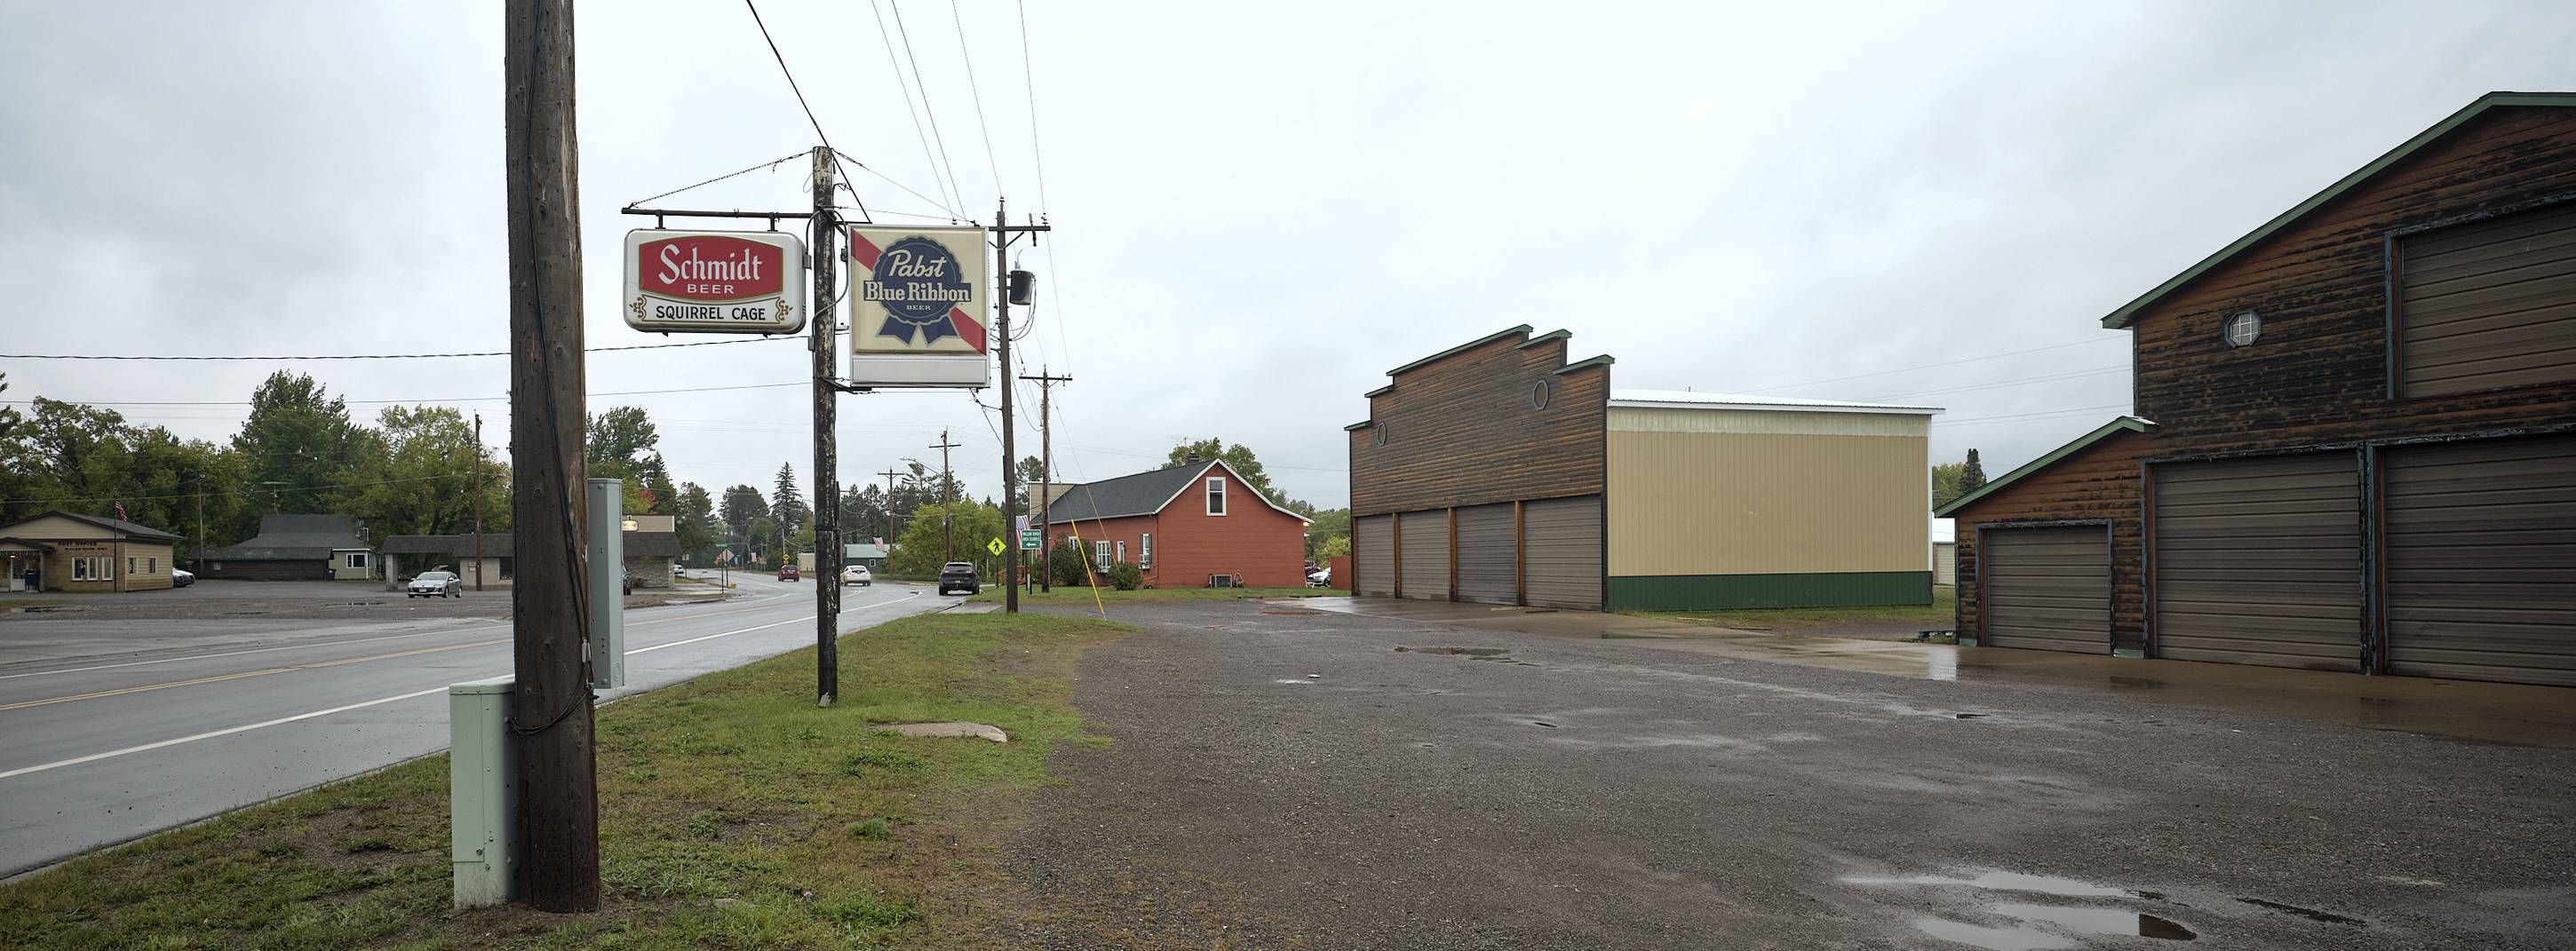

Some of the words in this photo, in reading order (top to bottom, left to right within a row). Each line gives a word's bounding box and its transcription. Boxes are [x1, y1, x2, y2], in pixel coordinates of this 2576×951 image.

[658, 244, 762, 285] Schmidt
[887, 249, 947, 277] Pabst
[688, 284, 735, 294] BEER
[865, 281, 905, 301] Blue
[907, 281, 970, 302] Ribbon
[656, 305, 724, 320] SQUIRREL
[731, 307, 766, 321] CAGE
